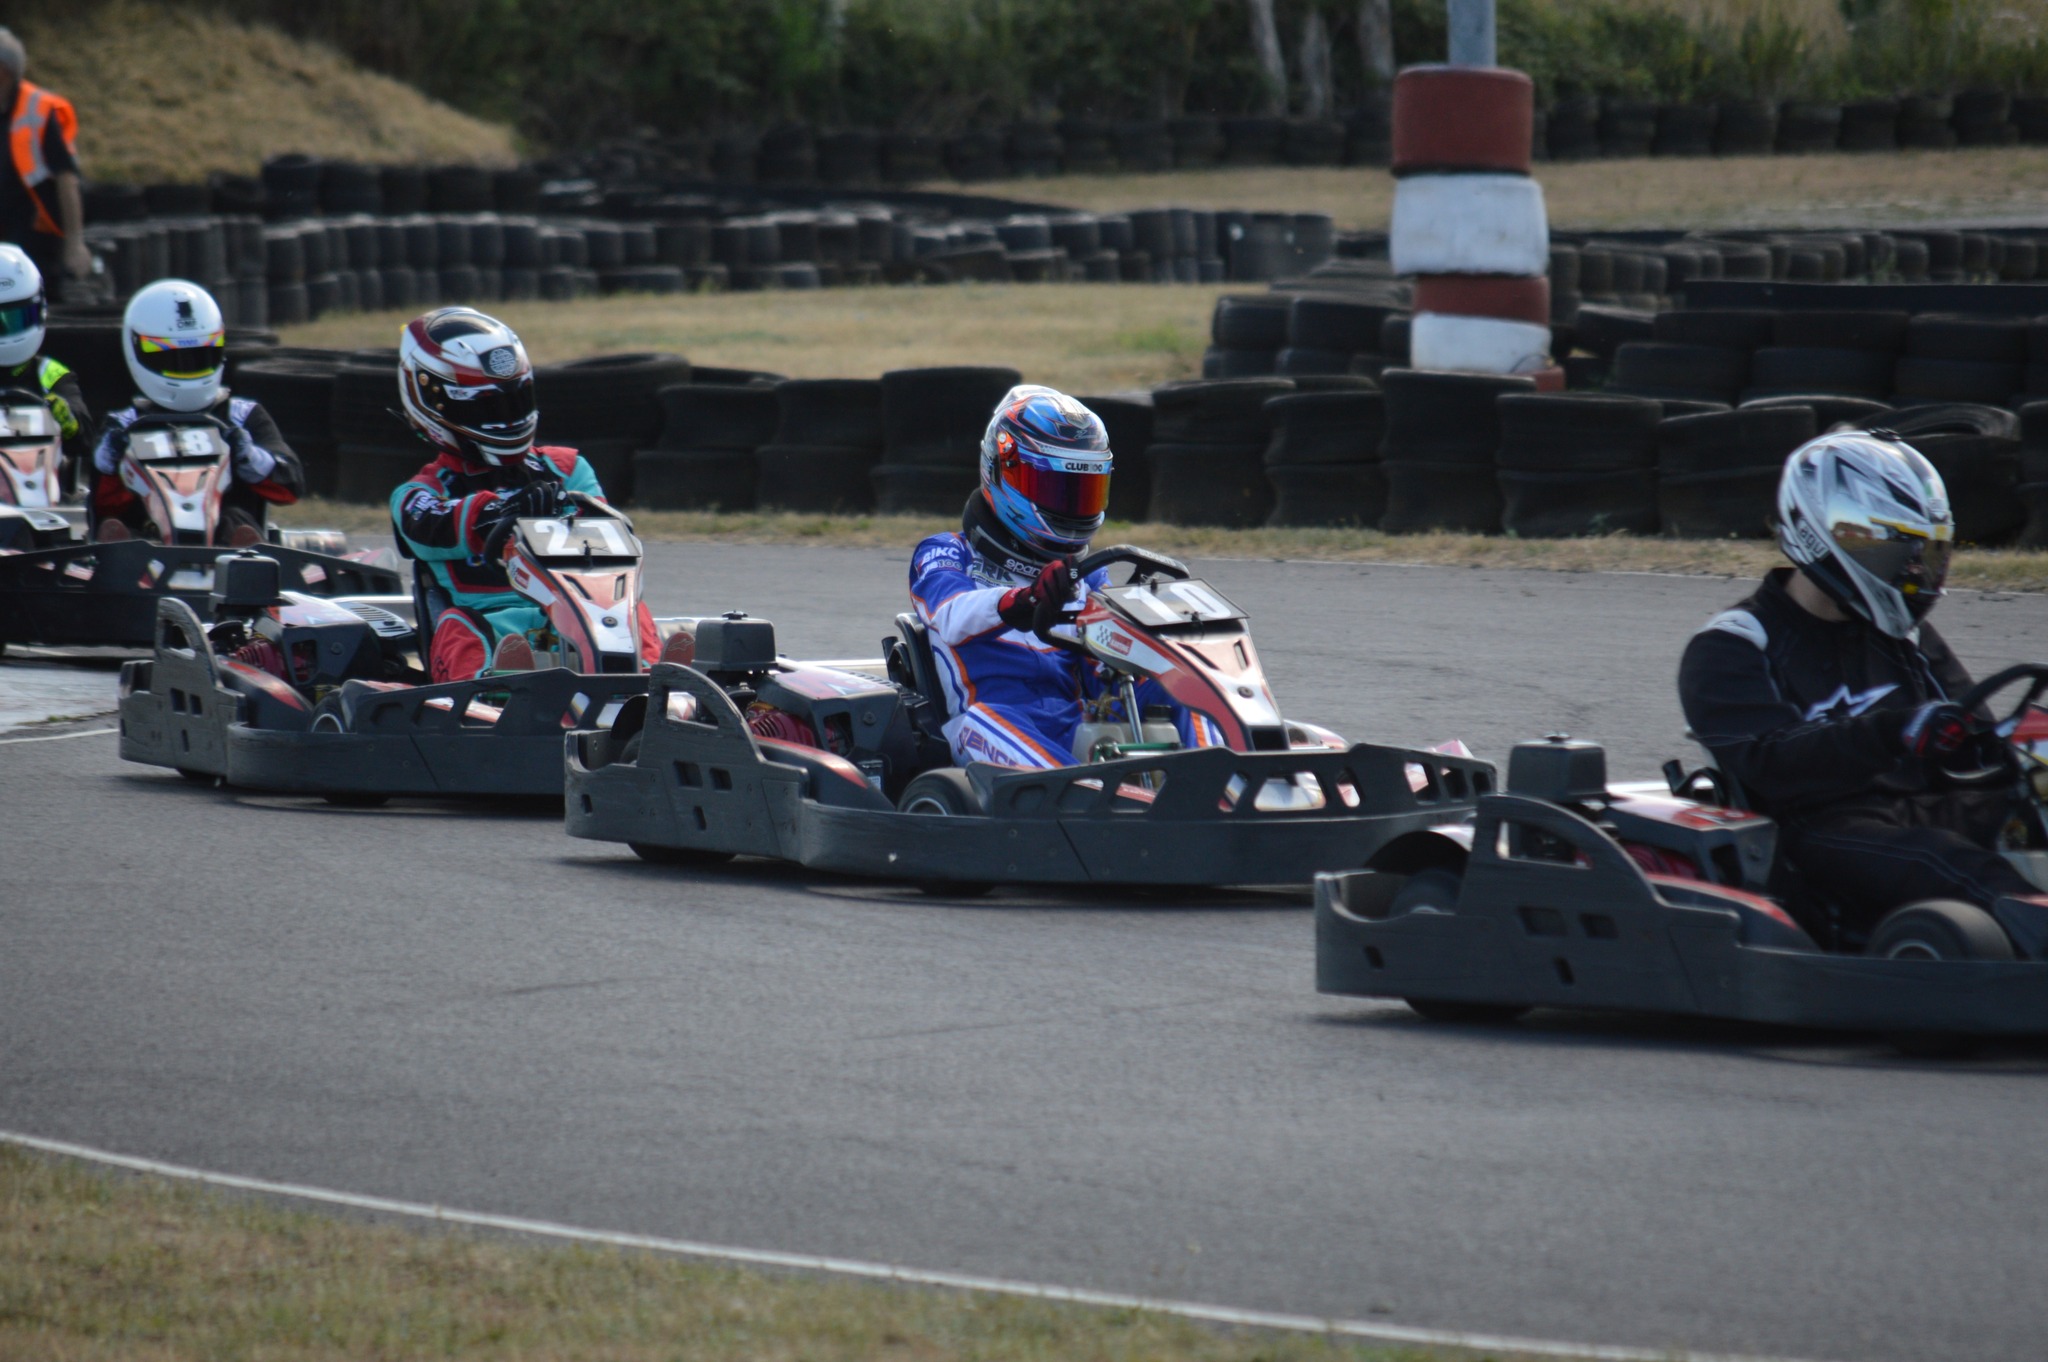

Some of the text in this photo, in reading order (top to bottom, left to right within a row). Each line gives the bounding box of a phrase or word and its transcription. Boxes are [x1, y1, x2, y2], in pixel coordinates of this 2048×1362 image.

[143, 429, 214, 458] 18
[534, 519, 631, 556] 27
[1798, 524, 1827, 554] agv
[1123, 582, 1231, 622] 10
